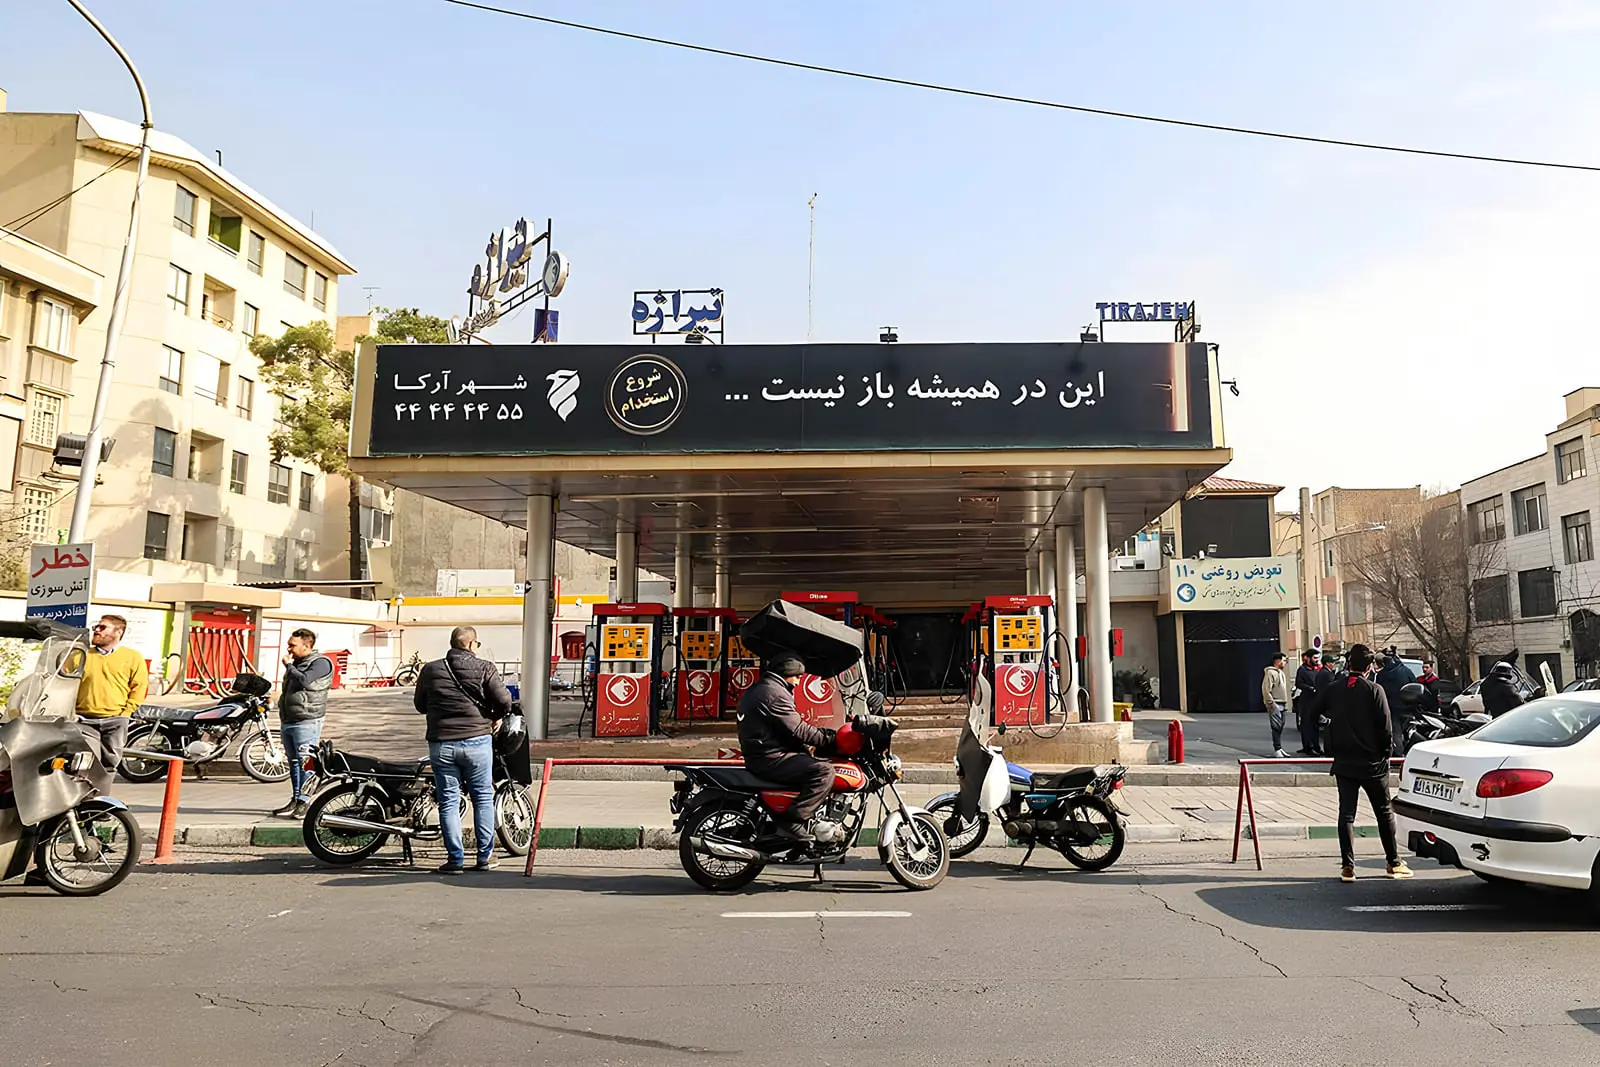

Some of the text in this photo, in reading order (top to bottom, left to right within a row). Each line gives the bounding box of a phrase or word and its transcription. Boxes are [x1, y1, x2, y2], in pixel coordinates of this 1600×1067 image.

[631, 287, 723, 334] تیراژه
[1096, 301, 1188, 321] TIRAJEH
[394, 369, 528, 396] شهر آرکا
[625, 368, 661, 393] شروع
[761, 374, 845, 408] نیست
[857, 371, 894, 409] باز
[908, 373, 1000, 407] همیشه
[1012, 379, 1047, 406] در
[1060, 370, 1104, 409] این
[621, 386, 674, 418] استخدام
[31, 547, 90, 578] خطر
[1176, 563, 1282, 581] تعویض روغنی ۱۱۰
[64, 578, 89, 597] آتش
